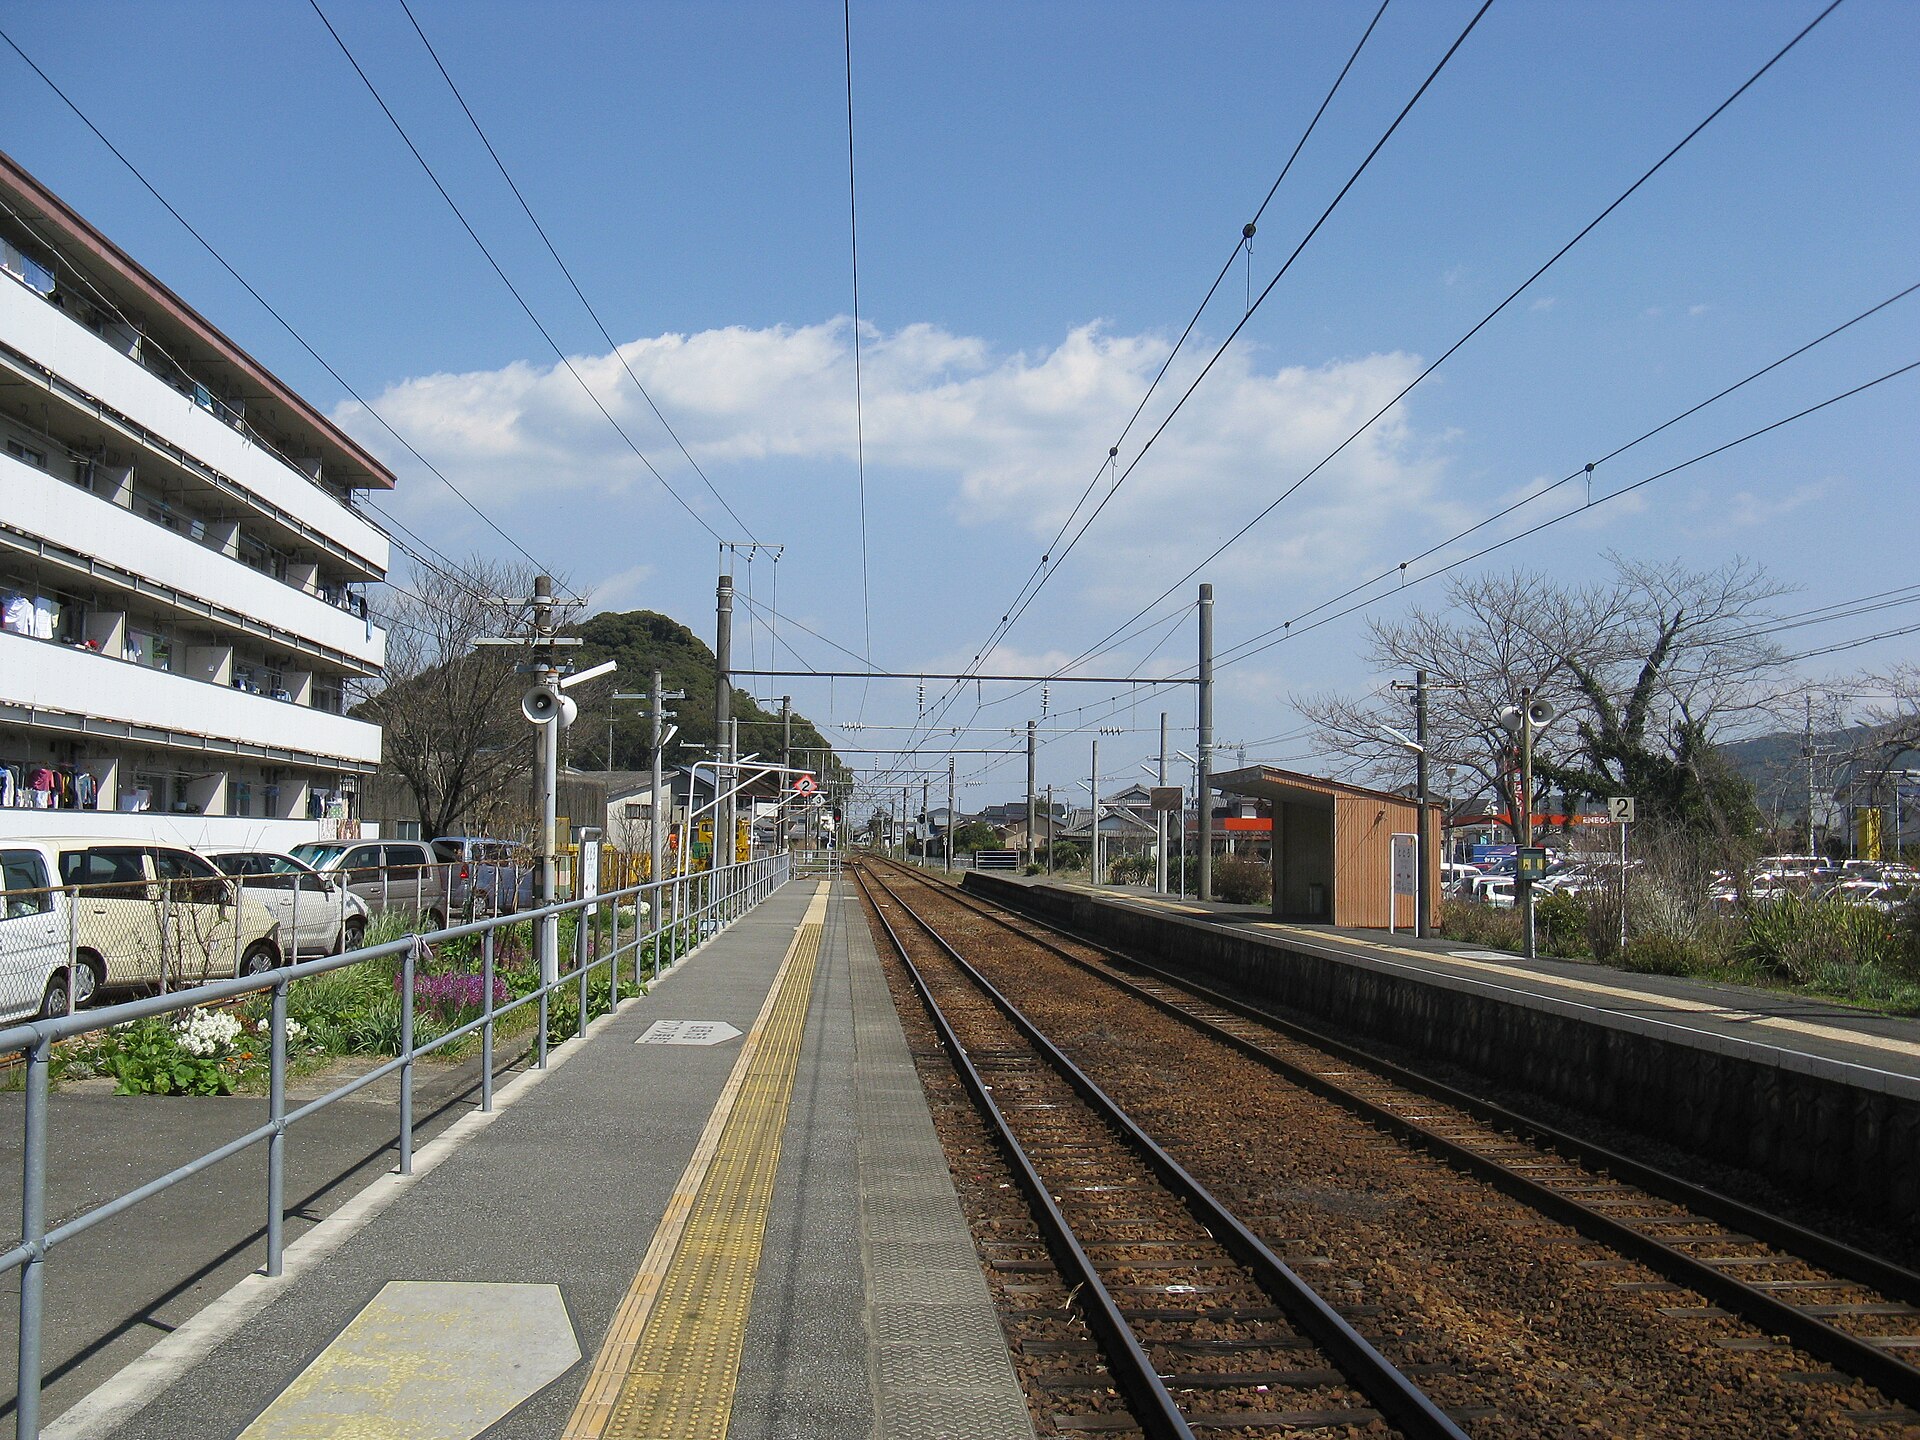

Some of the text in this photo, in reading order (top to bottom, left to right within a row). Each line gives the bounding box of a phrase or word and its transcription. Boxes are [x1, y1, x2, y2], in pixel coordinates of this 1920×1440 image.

[802, 780, 811, 791] 2
[679, 806, 684, 820] 1
[1617, 799, 1628, 817] 2
